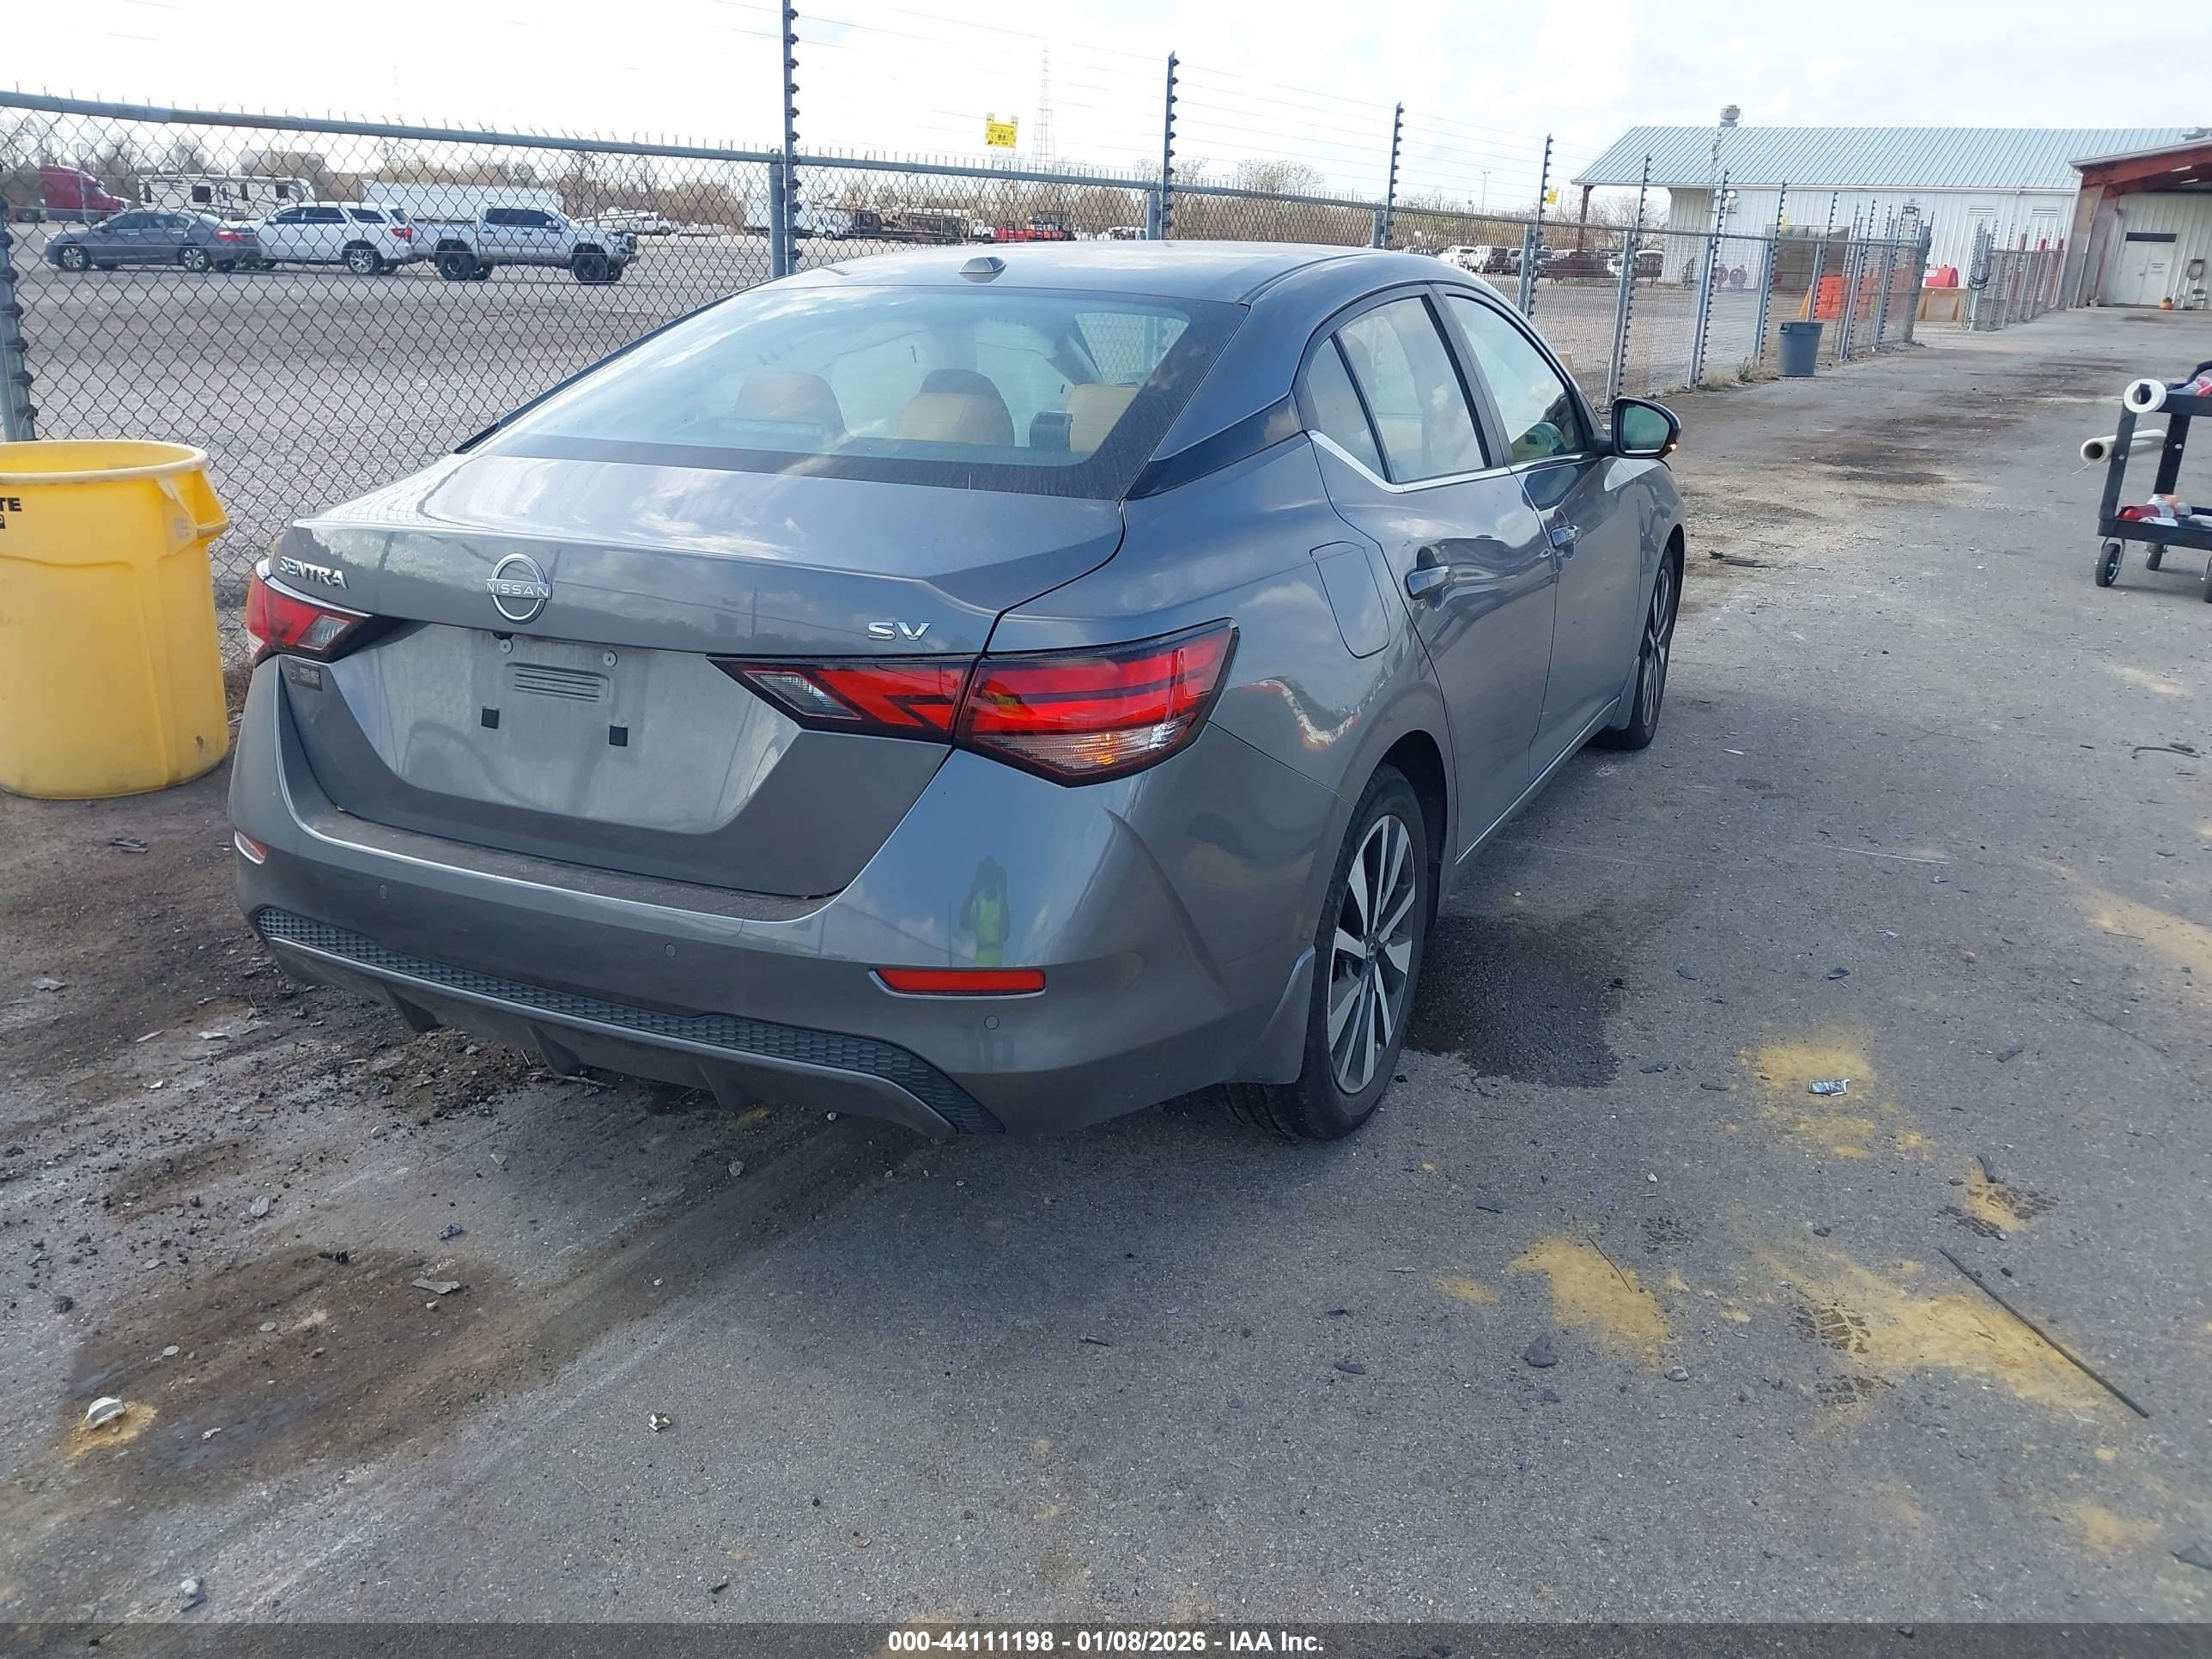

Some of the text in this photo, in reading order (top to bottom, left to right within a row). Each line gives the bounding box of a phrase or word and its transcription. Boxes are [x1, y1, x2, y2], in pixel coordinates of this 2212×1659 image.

[279, 556, 349, 589] SENTRA
[486, 582, 549, 598] NISSAN
[867, 621, 932, 641] SV
